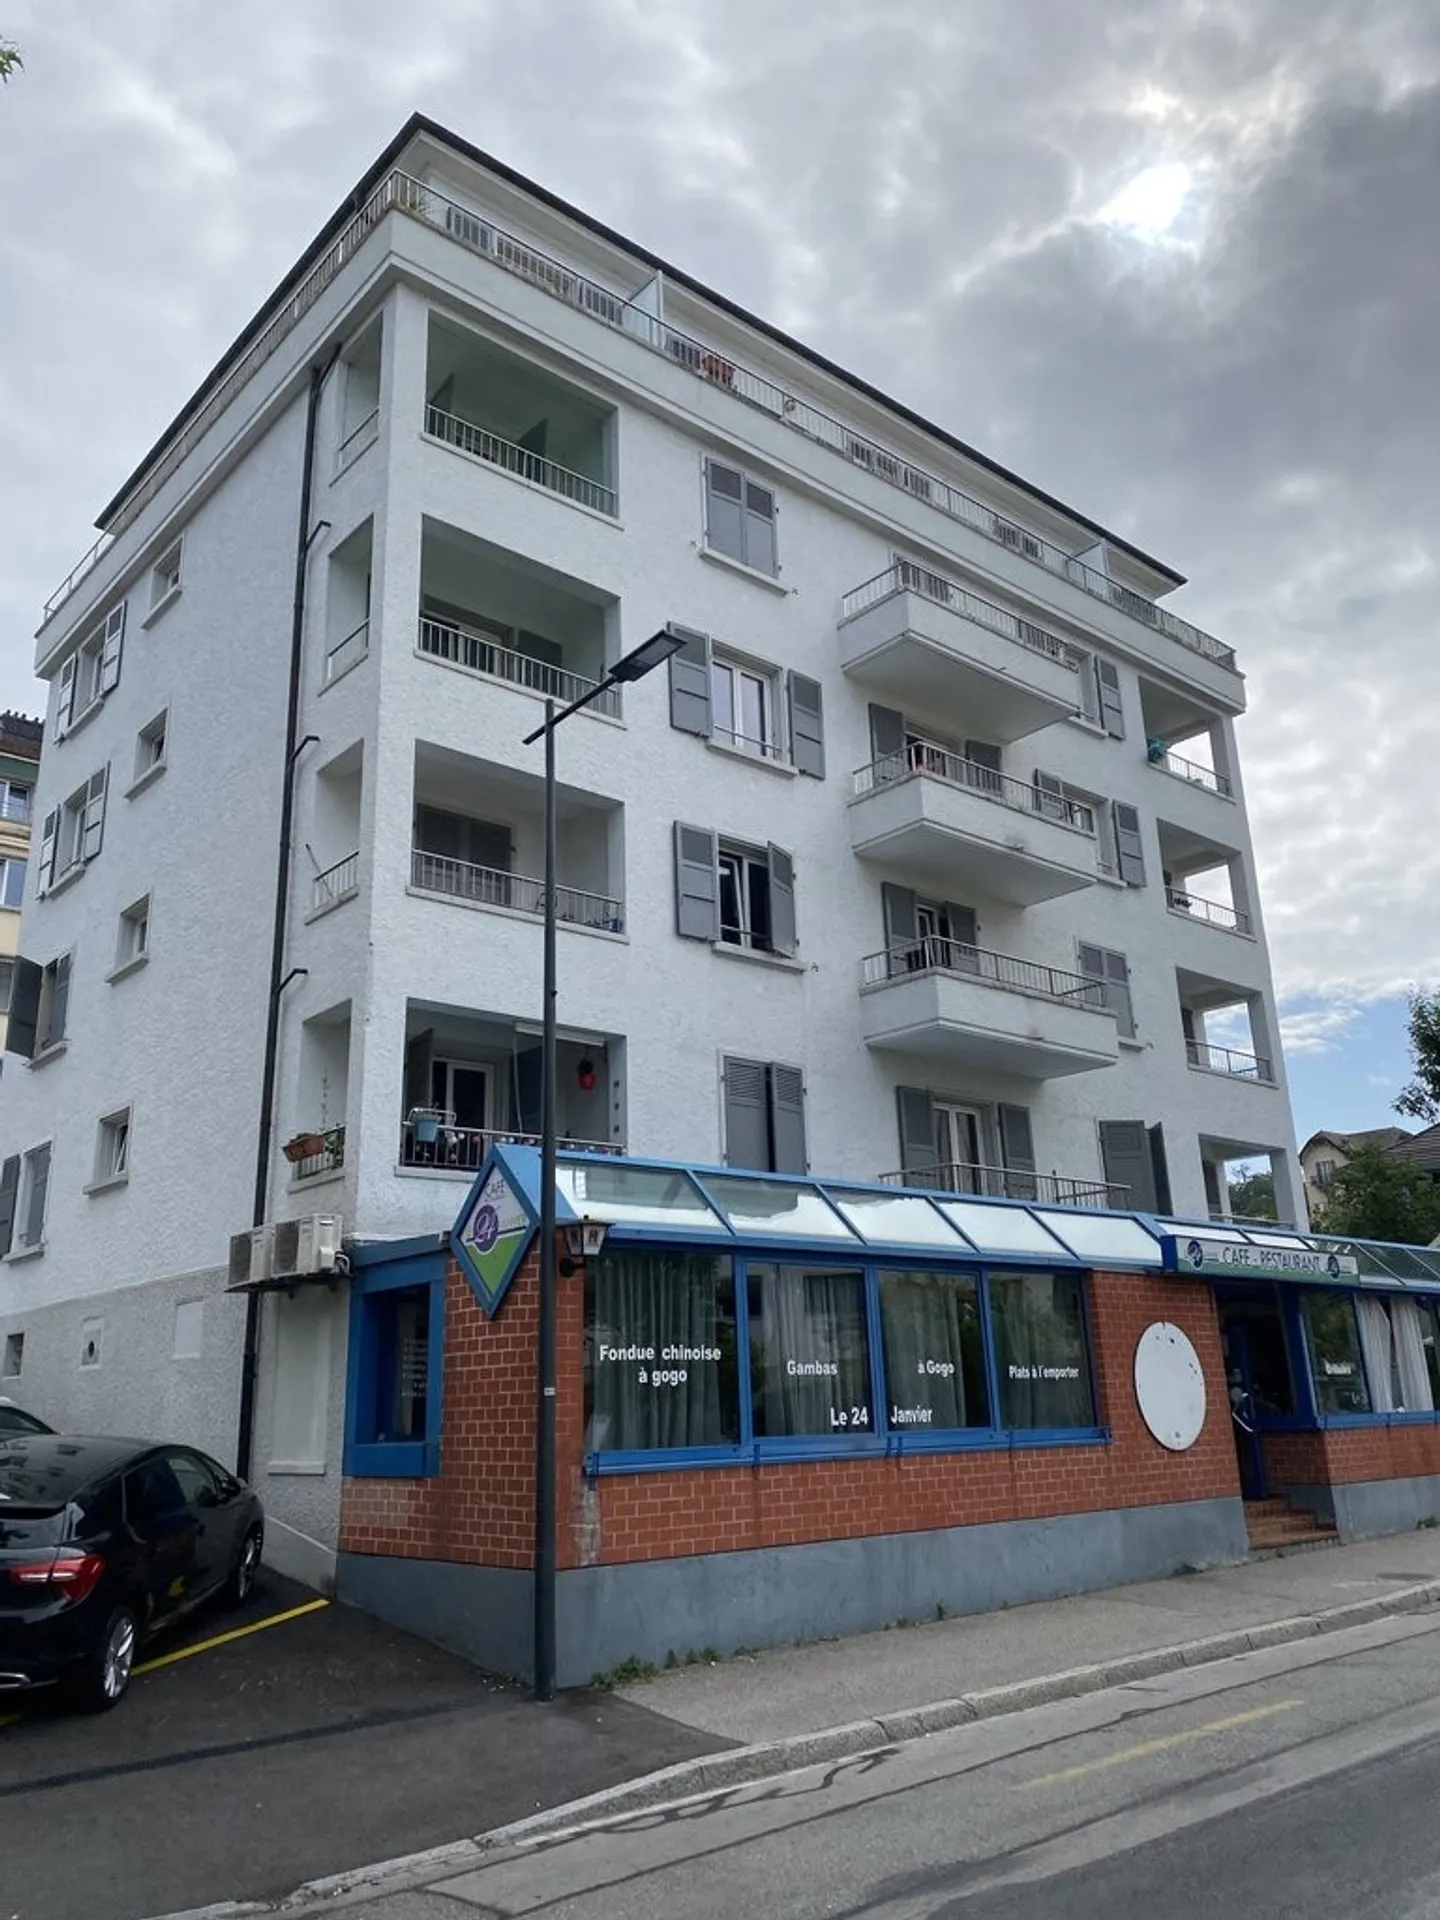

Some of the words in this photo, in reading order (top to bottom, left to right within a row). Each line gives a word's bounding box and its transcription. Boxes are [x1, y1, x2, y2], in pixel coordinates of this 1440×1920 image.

[600, 1344, 655, 1362] Fondue
[661, 1345, 722, 1361] chinoise
[638, 1366, 648, 1384] à
[652, 1367, 688, 1387] gogo
[787, 1359, 838, 1376] Gambas
[918, 1359, 926, 1374] à
[927, 1359, 955, 1377] Gogo
[1009, 1365, 1030, 1379] Plats
[830, 1407, 848, 1426] Le
[851, 1406, 869, 1425] 24
[890, 1404, 933, 1424] Janvier
